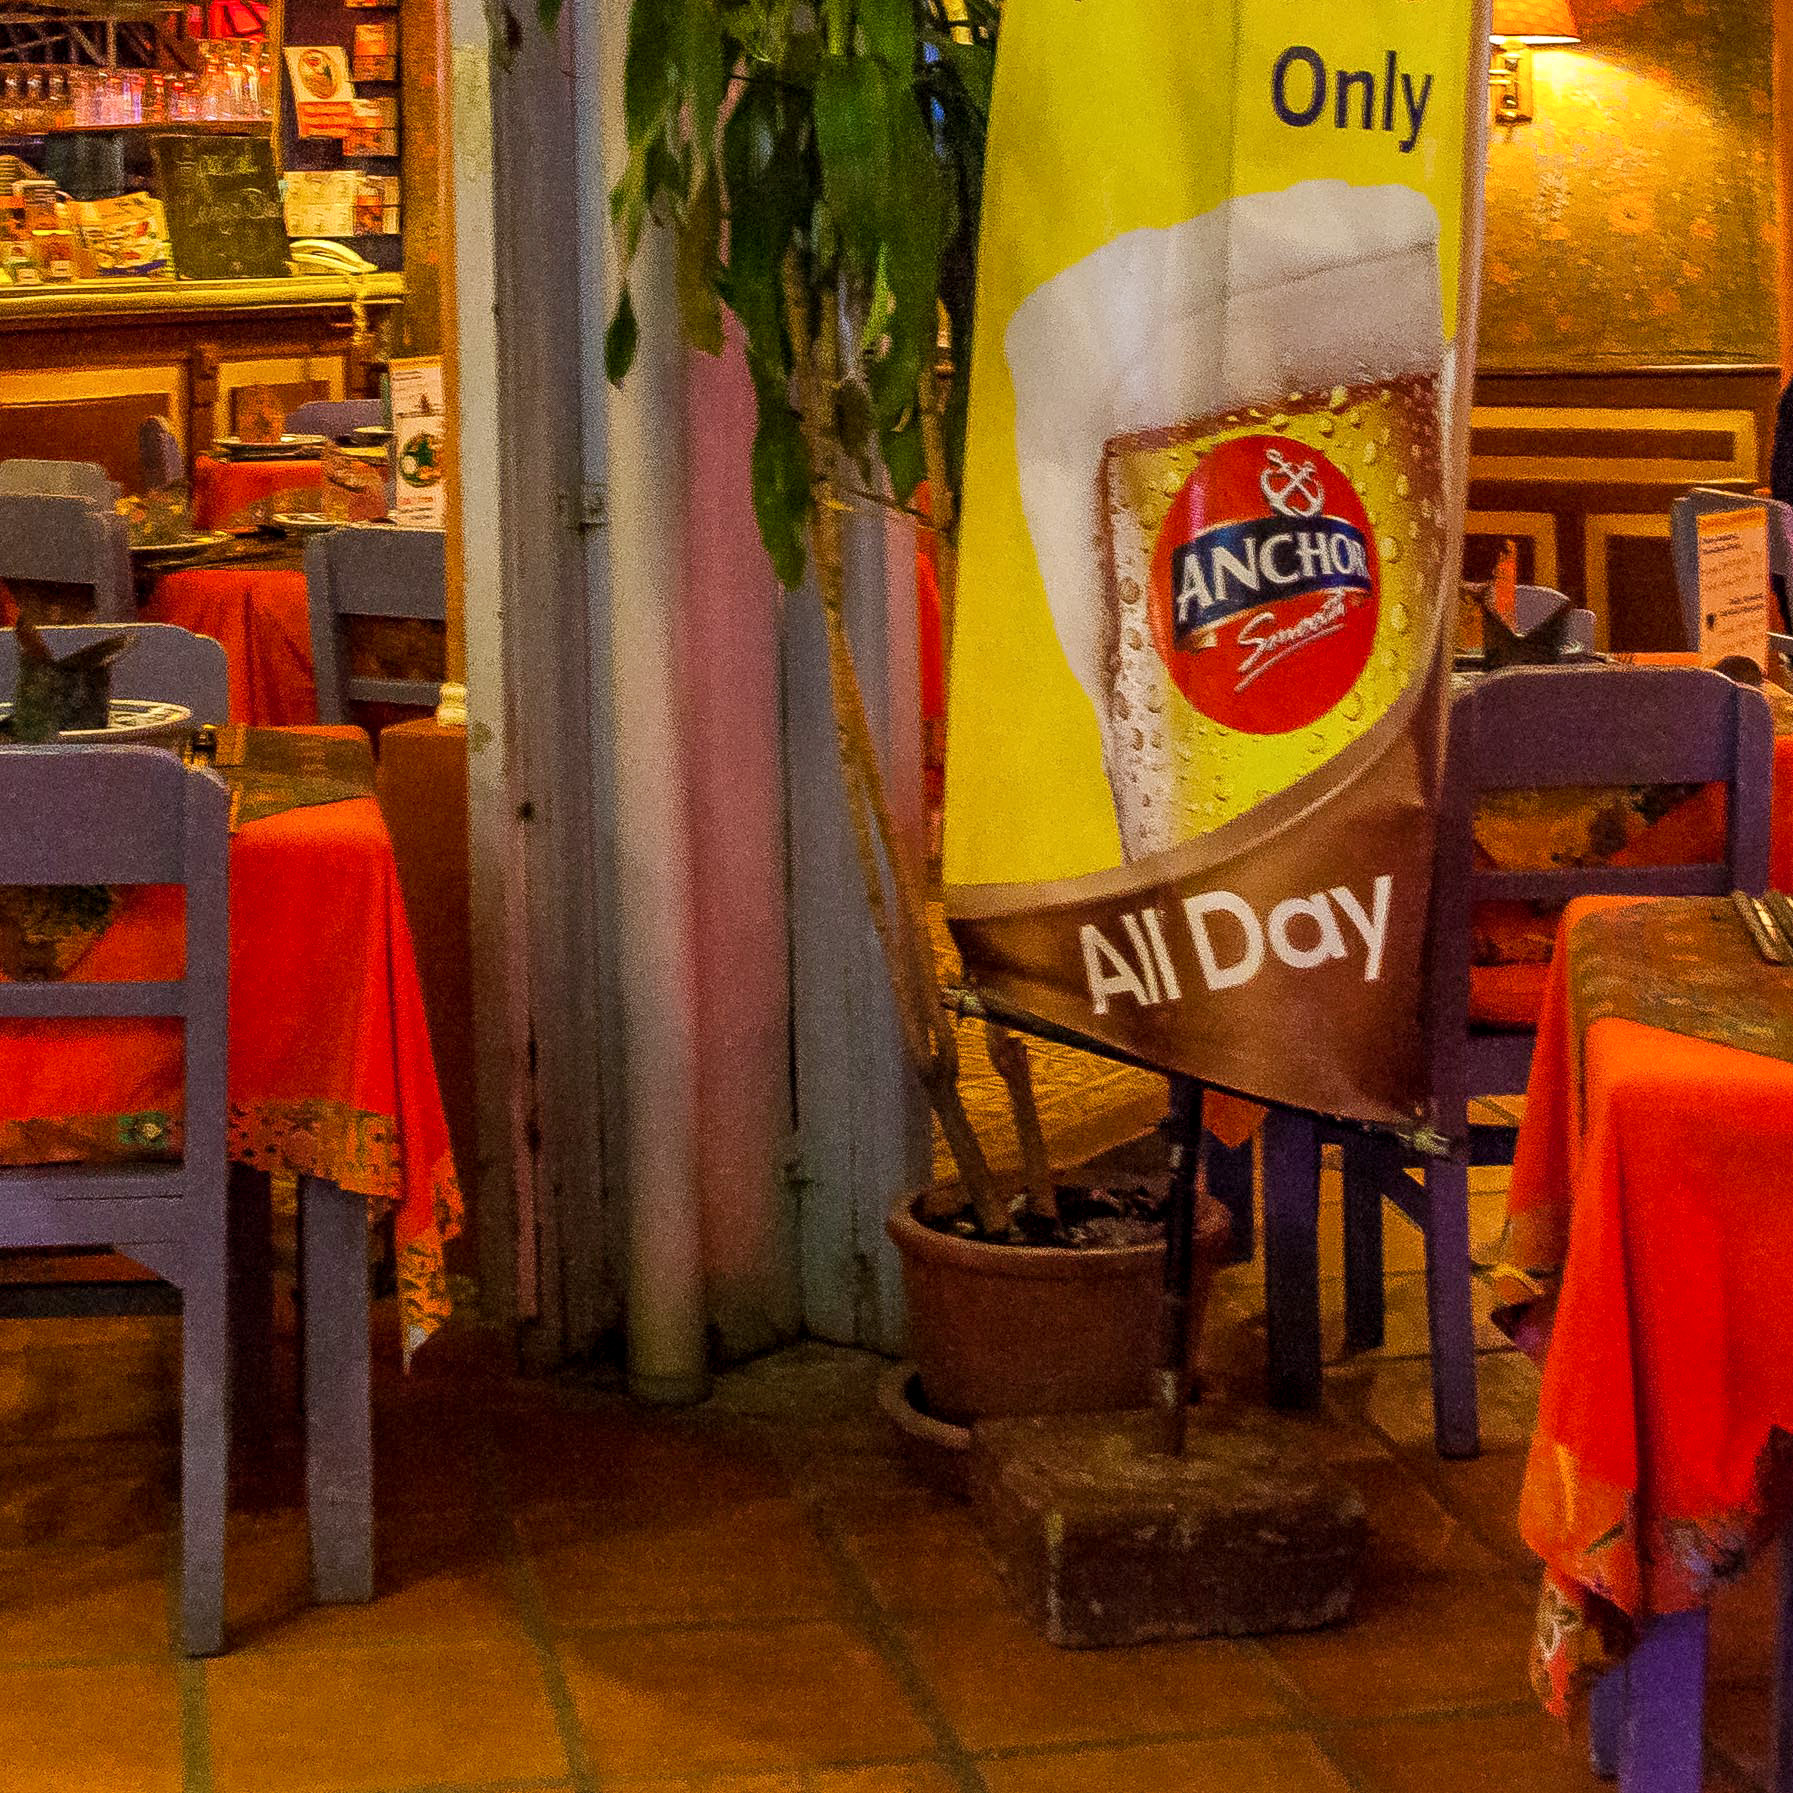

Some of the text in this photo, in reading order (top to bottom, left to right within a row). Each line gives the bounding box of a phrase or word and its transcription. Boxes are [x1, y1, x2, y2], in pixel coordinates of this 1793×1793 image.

[1271, 46, 1435, 154] Only
[1077, 874, 1393, 1017] All Day
